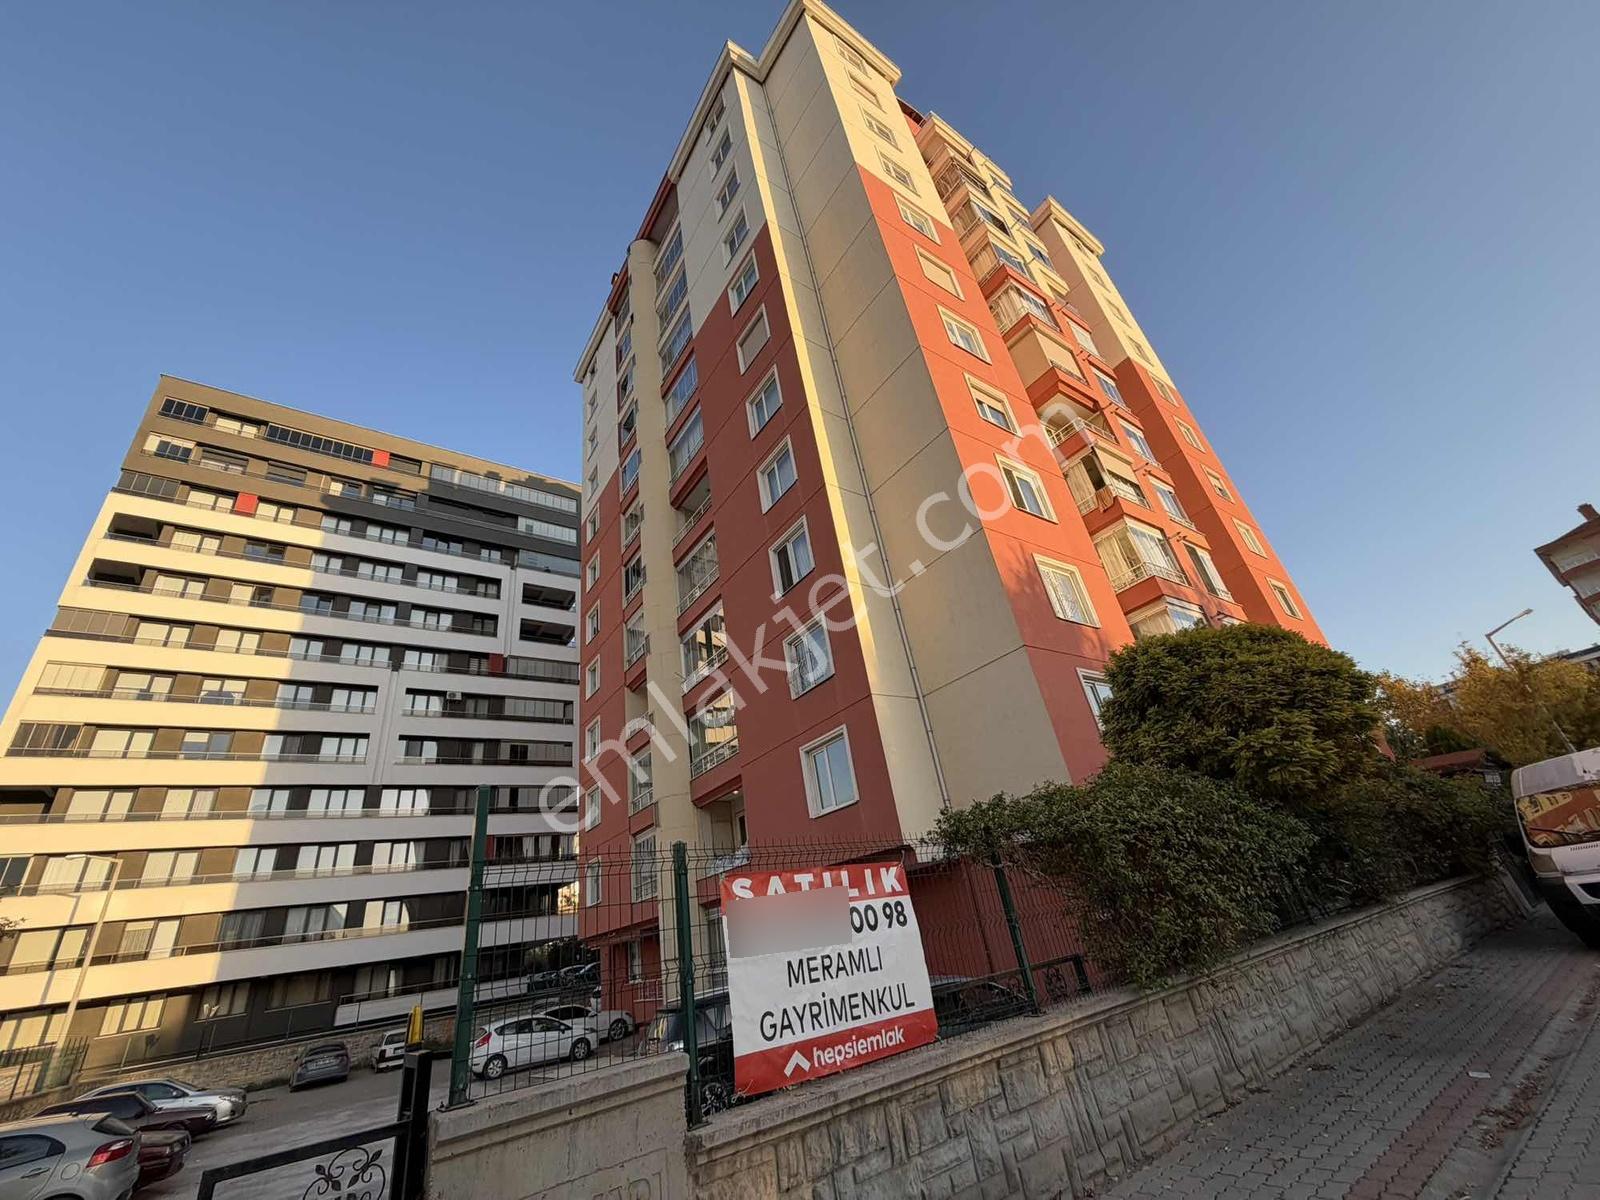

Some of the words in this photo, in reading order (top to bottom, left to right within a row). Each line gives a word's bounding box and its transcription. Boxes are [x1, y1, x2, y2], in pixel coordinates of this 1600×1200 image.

[882, 900, 908, 928] 98
[787, 946, 883, 988] MERAMLI
[760, 982, 915, 1042] GAYRİMENKUL
[813, 1026, 905, 1068] hepsiemlak
